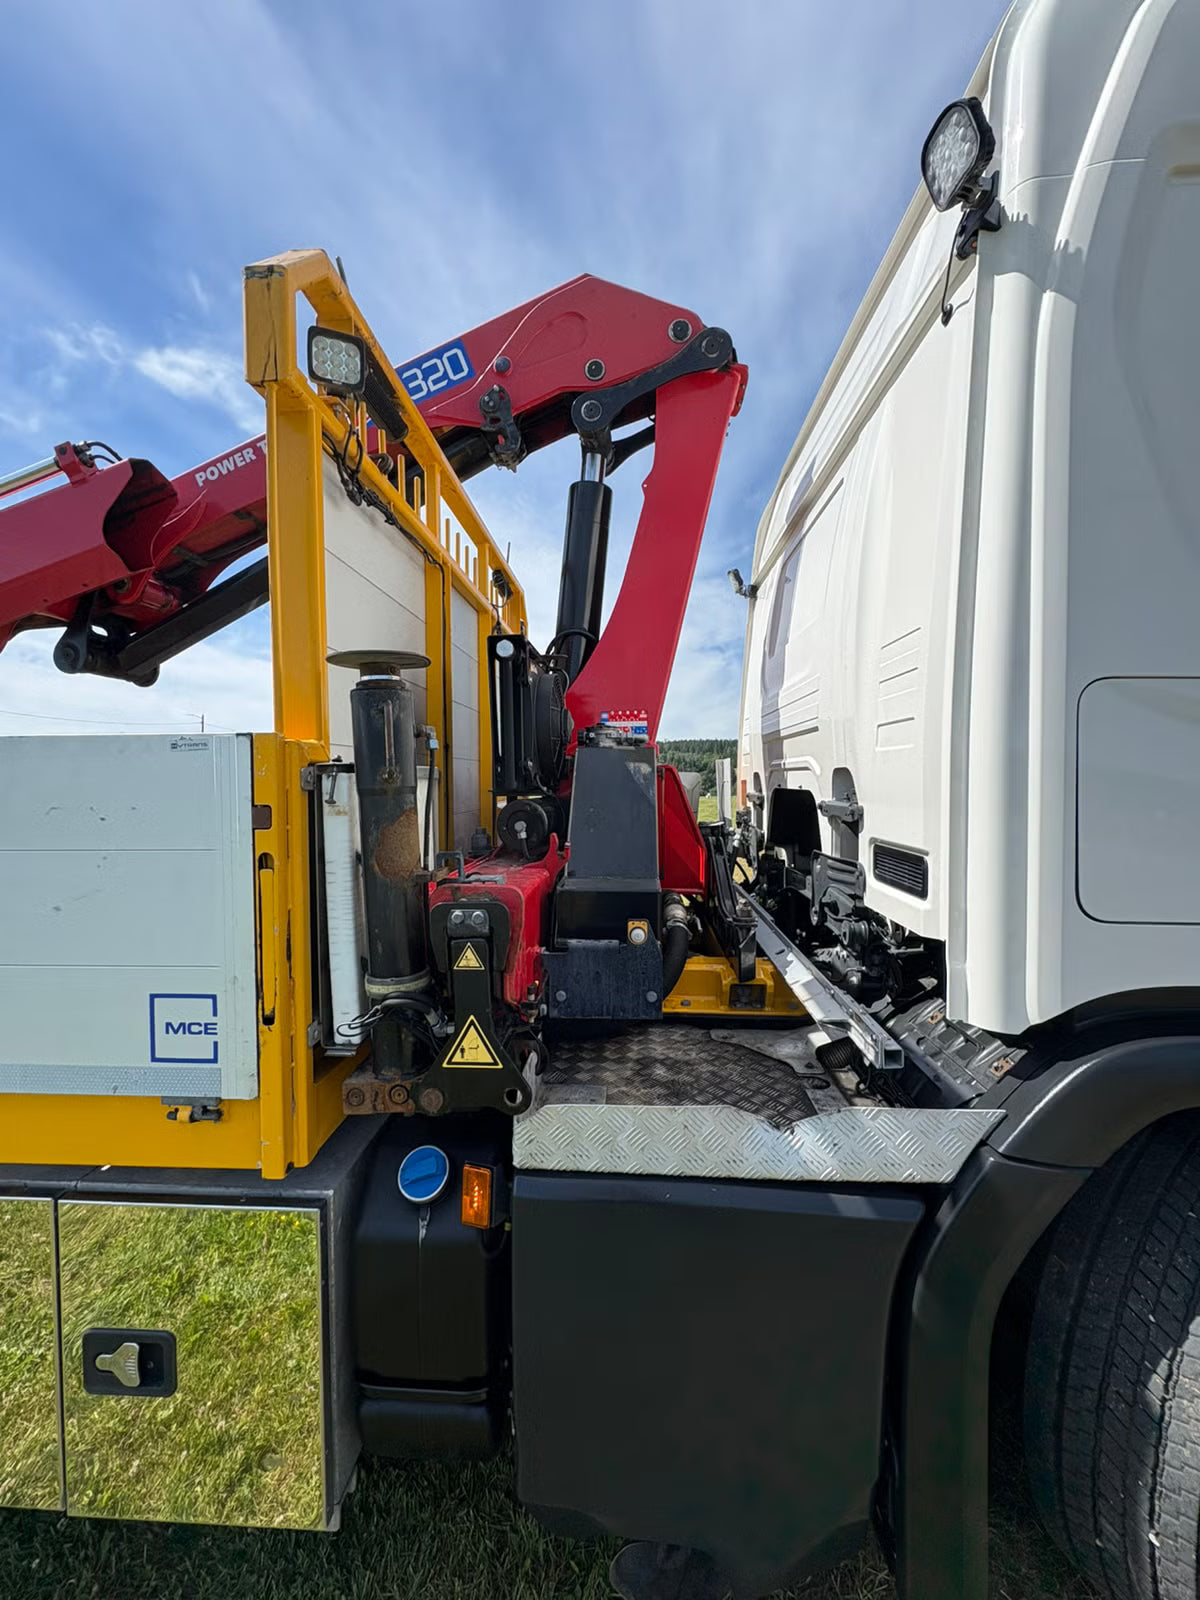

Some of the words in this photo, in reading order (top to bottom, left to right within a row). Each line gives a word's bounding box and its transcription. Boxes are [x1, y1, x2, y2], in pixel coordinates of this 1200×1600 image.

[401, 348, 468, 400] 320
[195, 447, 256, 487] POWER
[165, 1022, 218, 1035] MCE
